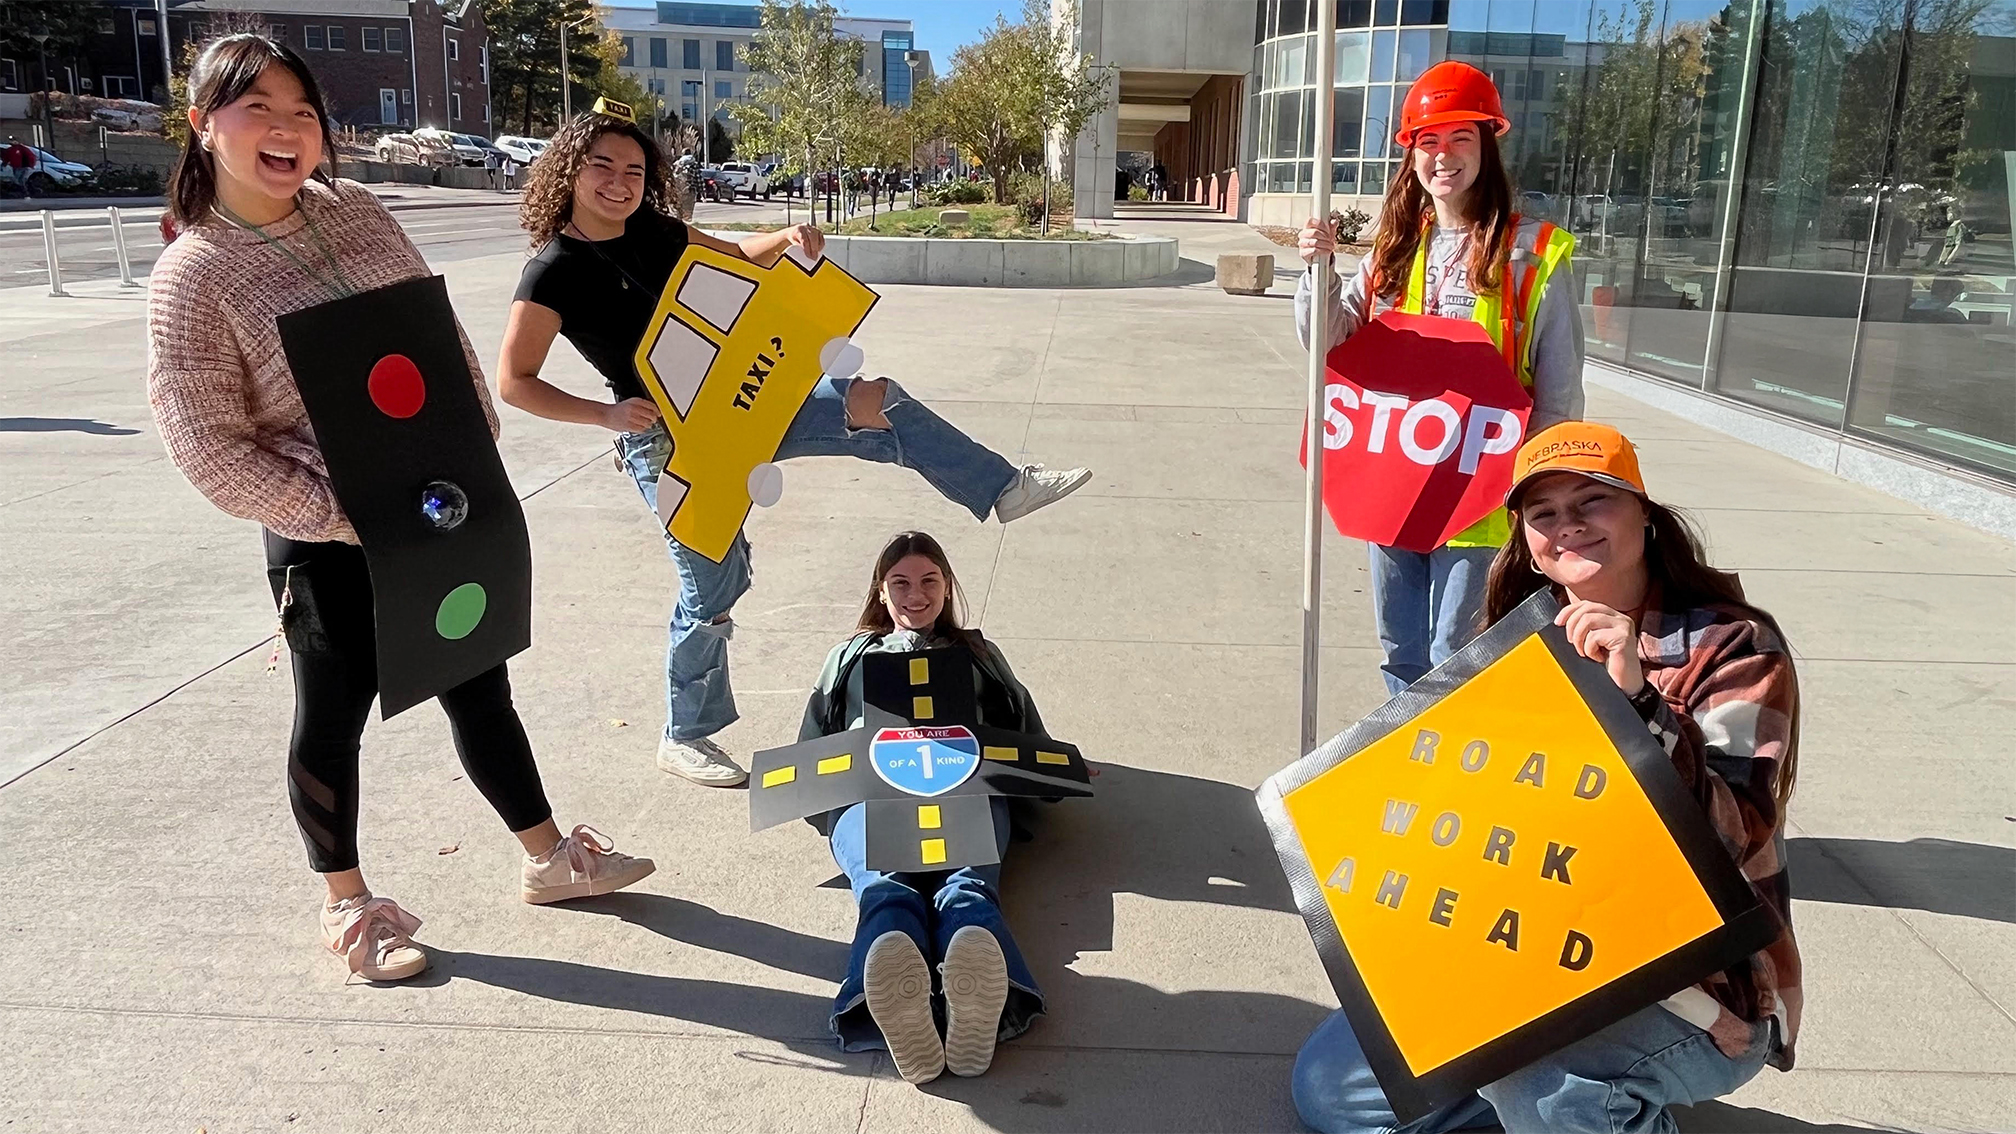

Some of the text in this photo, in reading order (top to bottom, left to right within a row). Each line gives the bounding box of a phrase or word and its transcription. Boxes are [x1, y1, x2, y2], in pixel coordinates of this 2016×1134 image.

[609, 103, 628, 114] TAXI
[1323, 383, 1522, 476] STOP
[1527, 440, 1602, 466] NEBRASKA
[898, 729, 950, 739] YOU ARE
[889, 744, 966, 779] OF A 1 KIND
[1409, 729, 1607, 800] ROAD
[1381, 799, 1578, 885] WORK
[1324, 857, 1594, 972] AHEAD
